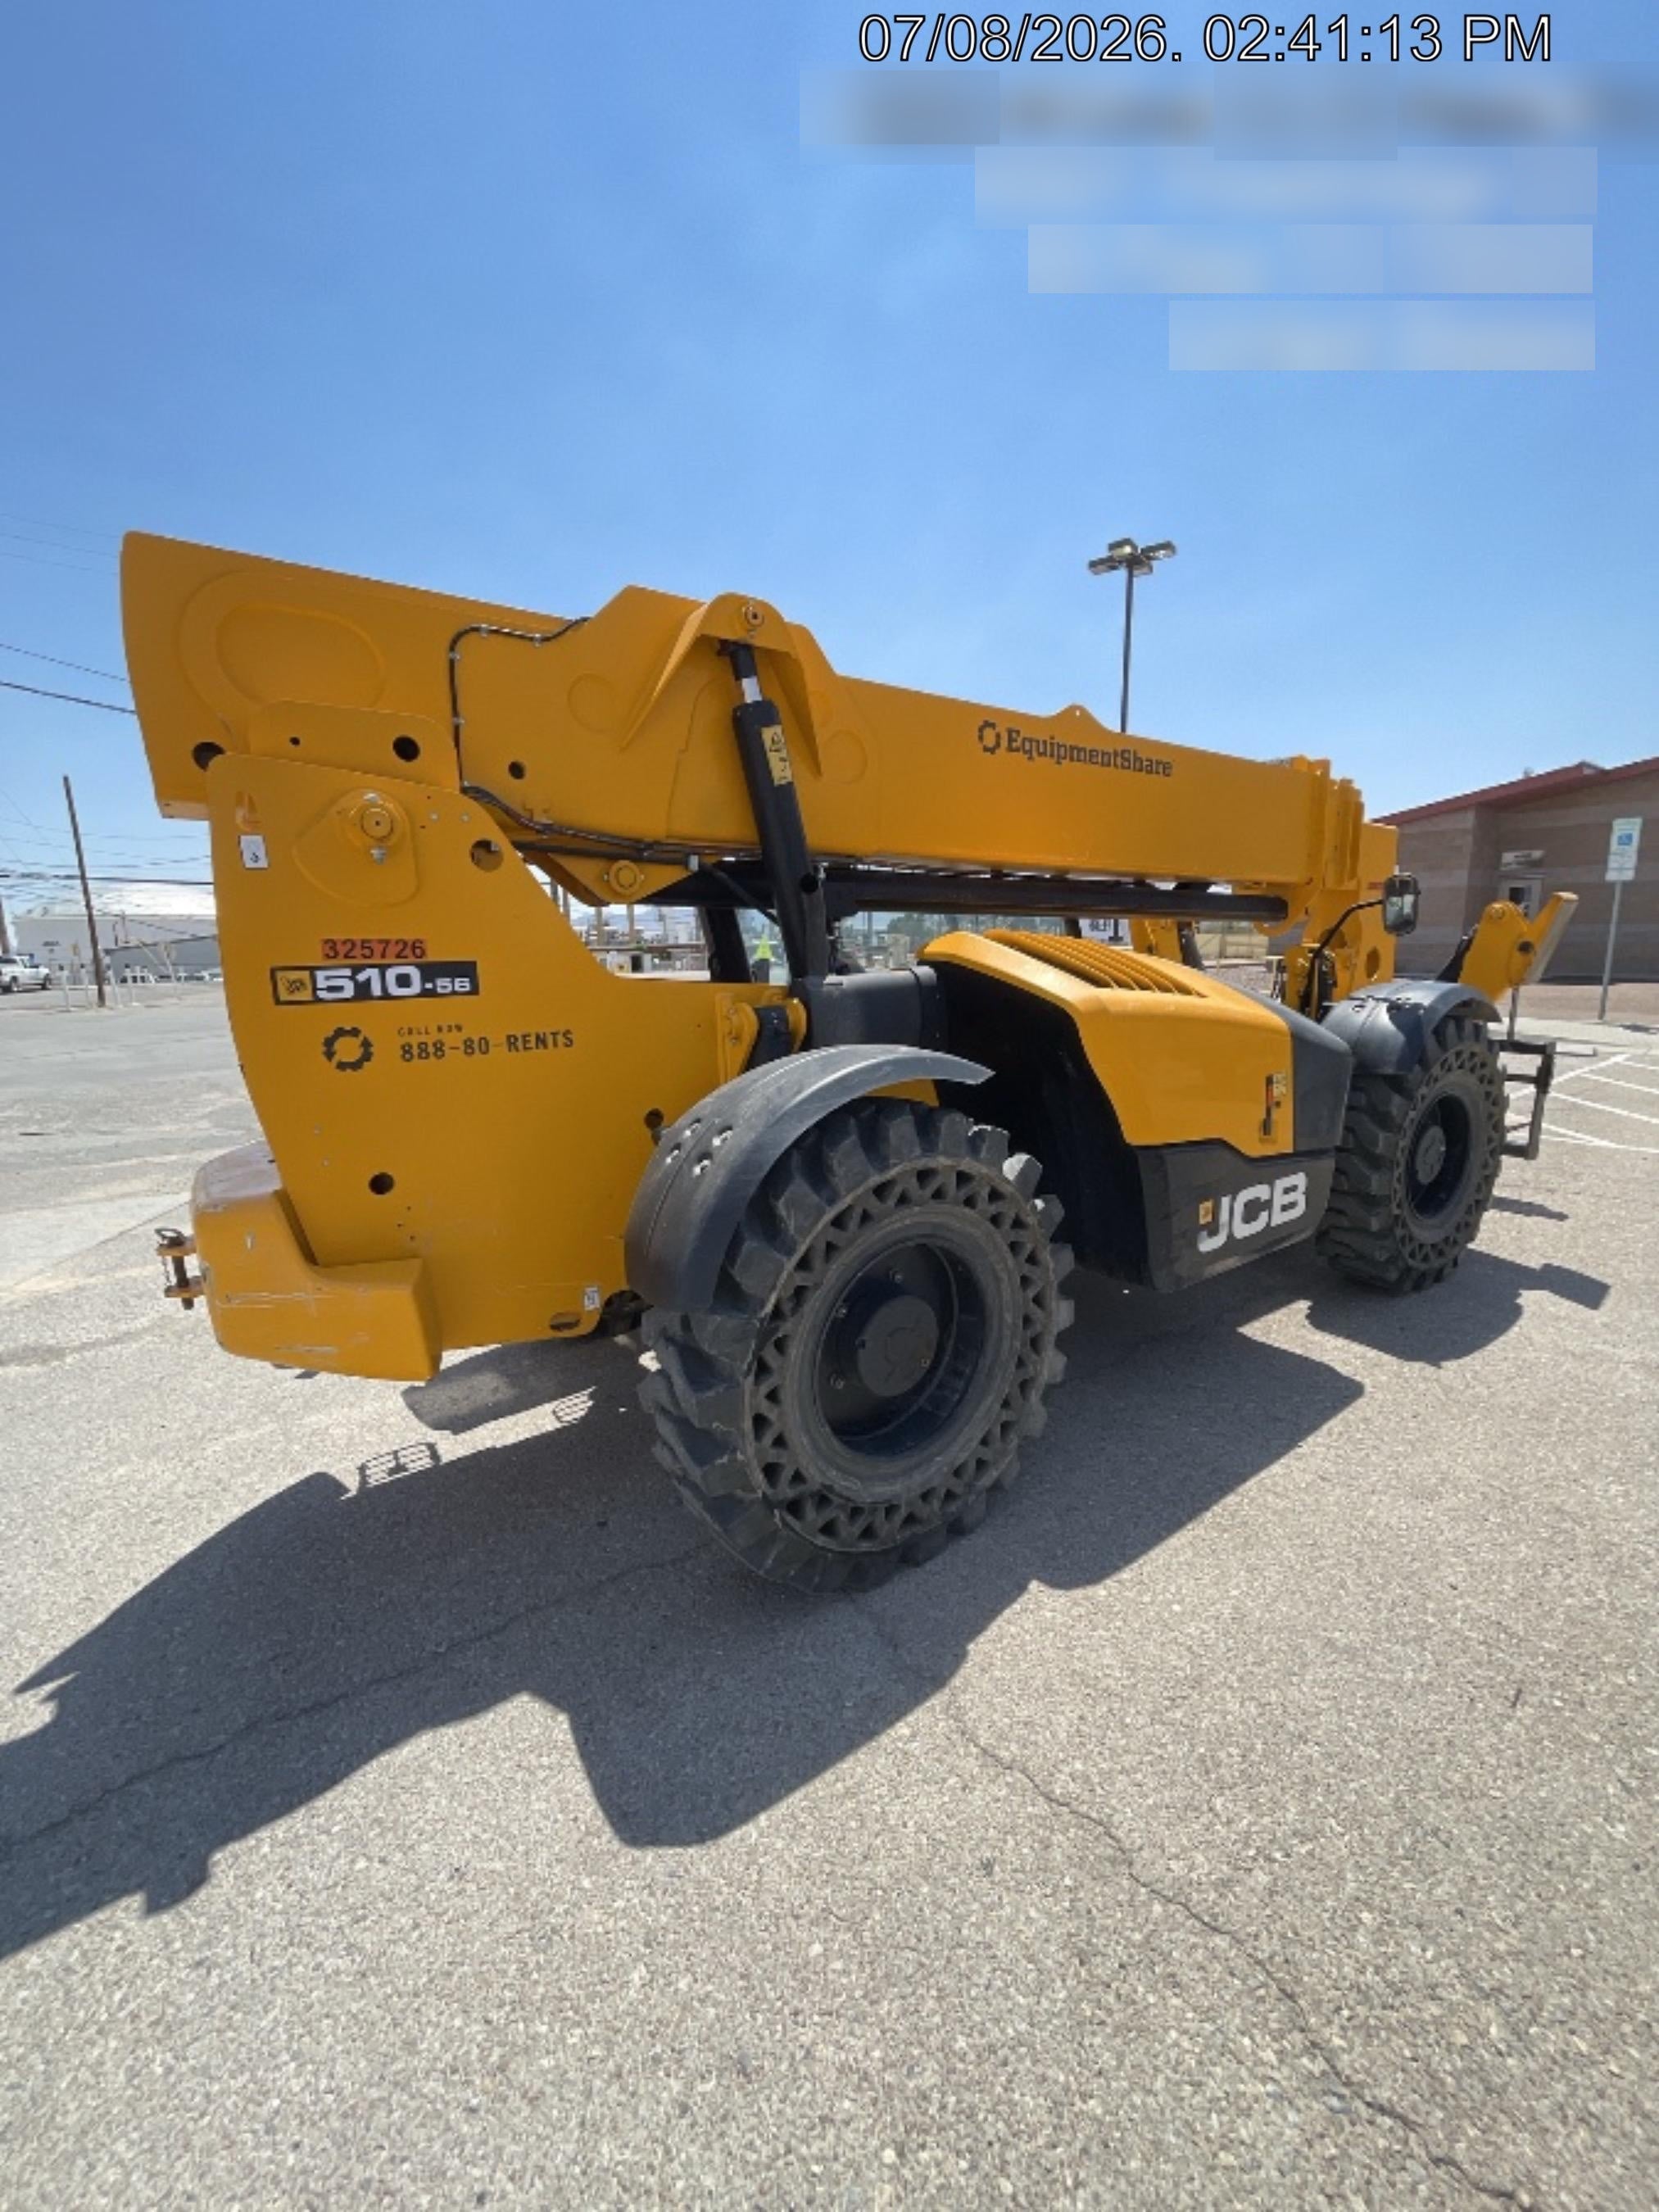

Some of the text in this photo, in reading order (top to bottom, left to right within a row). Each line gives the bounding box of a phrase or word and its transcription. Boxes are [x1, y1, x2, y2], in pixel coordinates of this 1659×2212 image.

[1006, 728, 1172, 777] EquipmentShare
[324, 938, 425, 959] 325726
[1198, 1172, 1308, 1253] JCB
